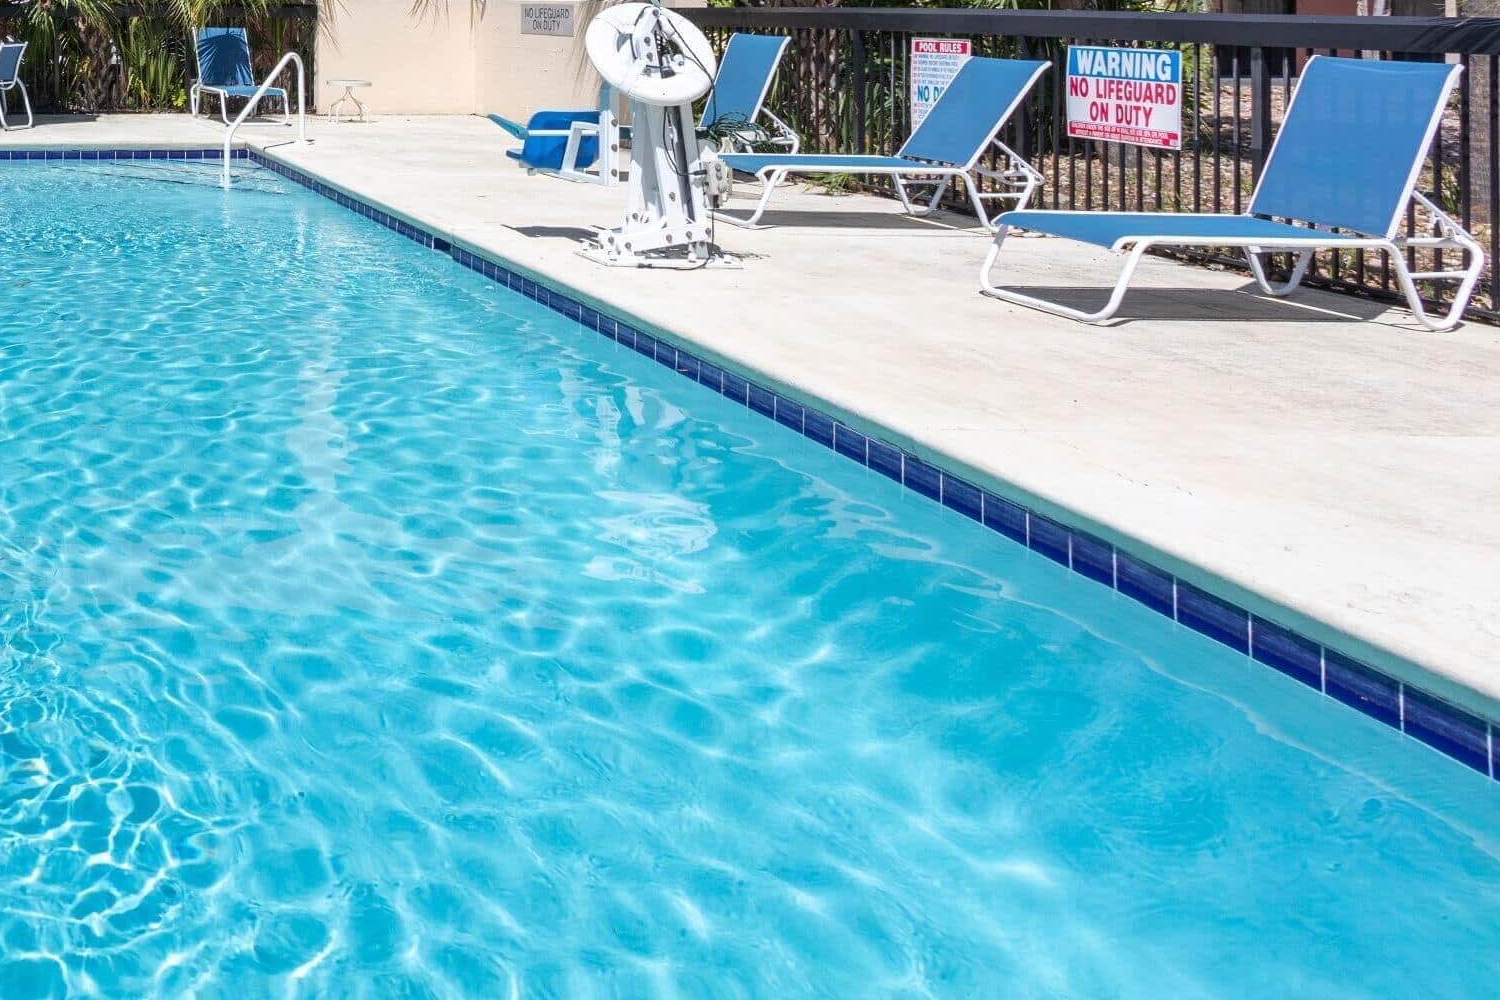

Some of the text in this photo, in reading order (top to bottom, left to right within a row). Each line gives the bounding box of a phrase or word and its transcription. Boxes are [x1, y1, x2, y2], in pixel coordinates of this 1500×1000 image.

[524, 8, 570, 19] NO LIFEGUARD
[533, 19, 561, 31] ON DUTY
[919, 42, 962, 53] POOL RULES
[1076, 49, 1172, 81] WARNING
[917, 85, 930, 102] NO
[1069, 76, 1177, 106] NO LIFEGUARD
[1089, 101, 1153, 127] ON DUTY
